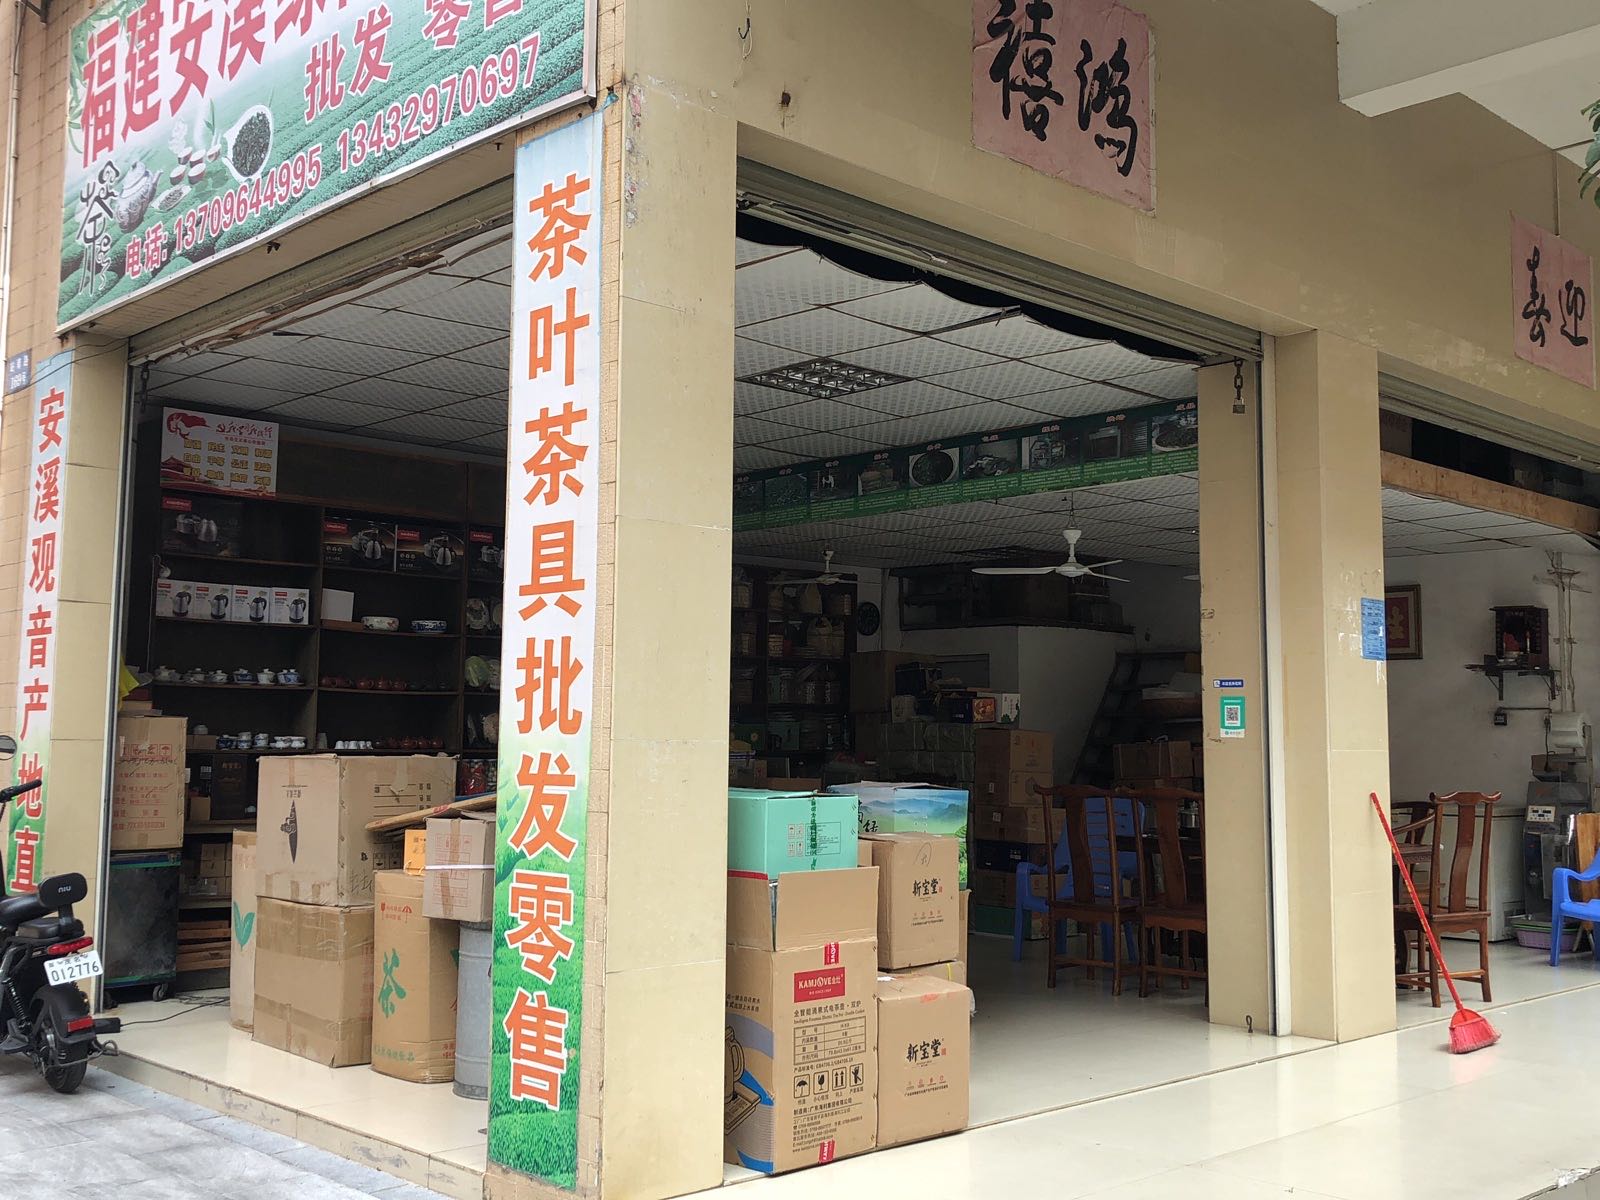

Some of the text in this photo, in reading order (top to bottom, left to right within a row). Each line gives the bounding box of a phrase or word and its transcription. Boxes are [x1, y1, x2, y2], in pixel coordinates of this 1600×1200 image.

[304, 2, 393, 122] 批发
[338, 33, 540, 171] 13432970697
[505, 172, 593, 1110] 茶叶茶具批发零售
[912, 877, 939, 897] 新宝堂
[51, 960, 100, 982] 012776
[906, 1038, 941, 1063] 新宝堂
